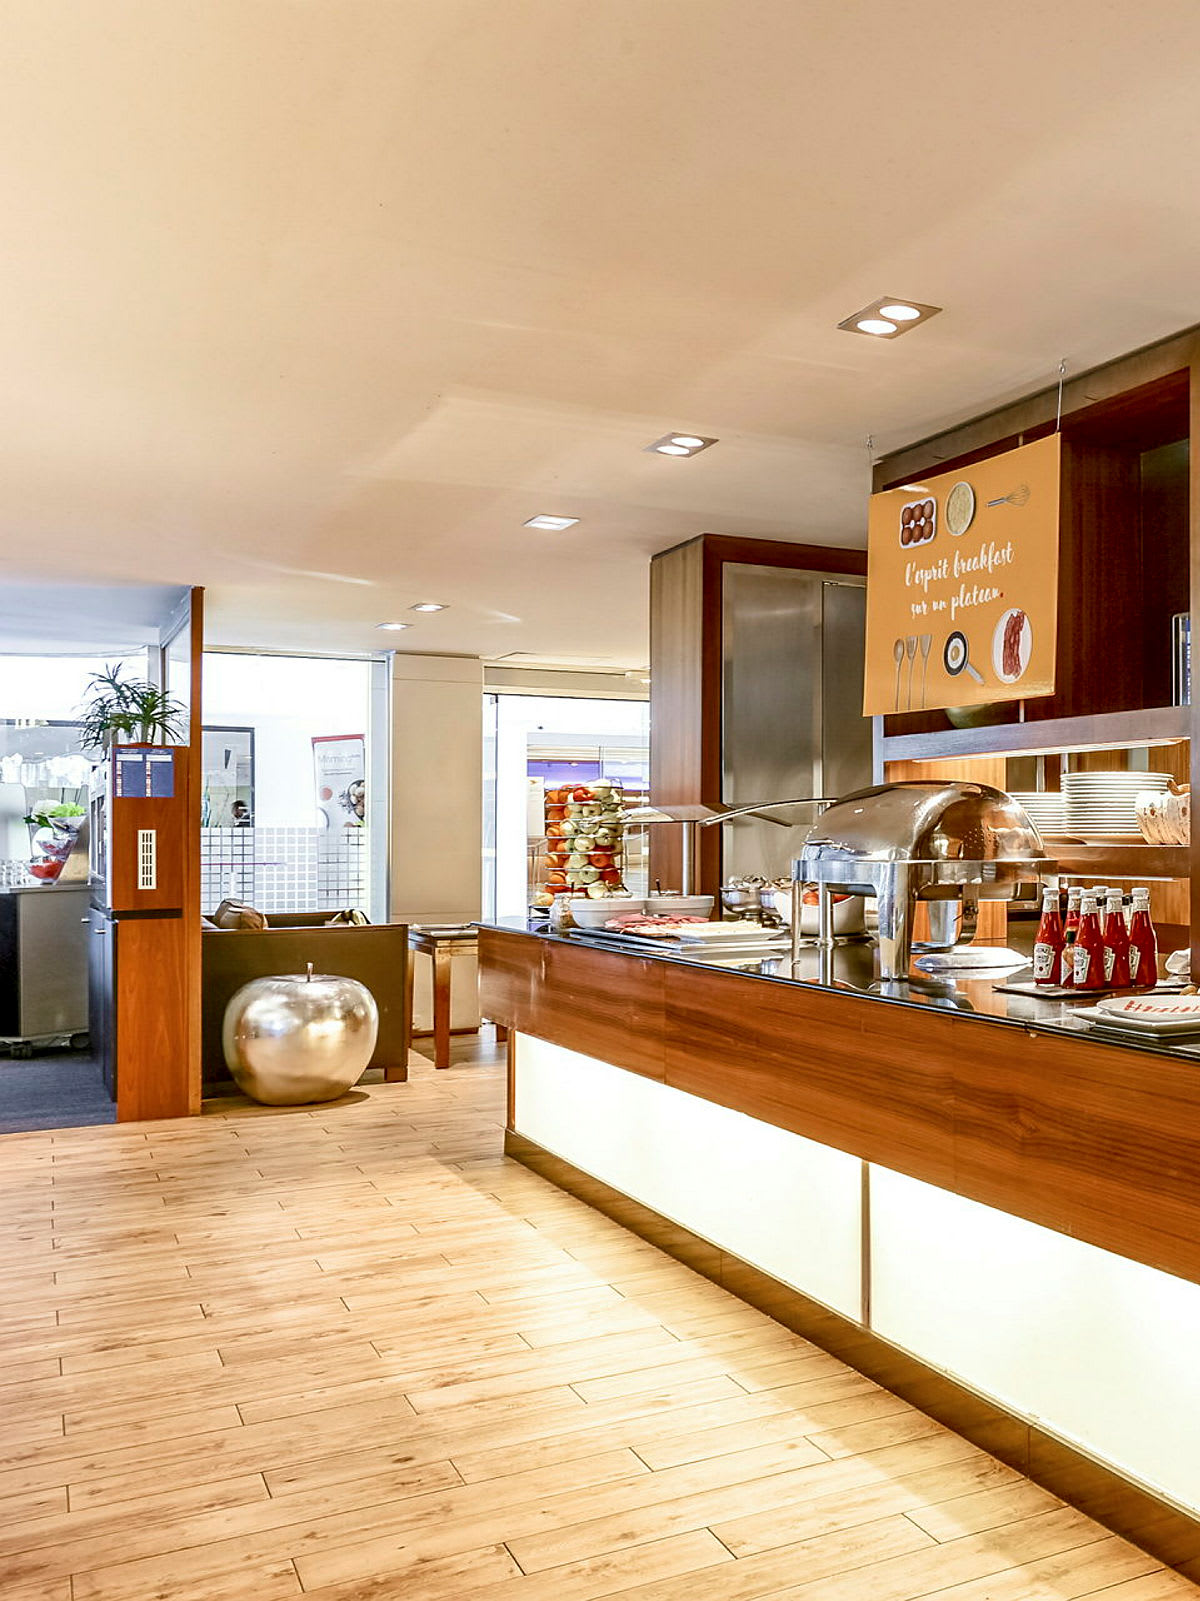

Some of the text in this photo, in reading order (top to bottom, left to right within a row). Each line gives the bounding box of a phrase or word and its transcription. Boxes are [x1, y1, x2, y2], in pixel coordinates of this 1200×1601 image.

[905, 541, 1015, 593] l'esprit breakfast
[911, 600, 928, 619] sur
[932, 600, 947, 611] un
